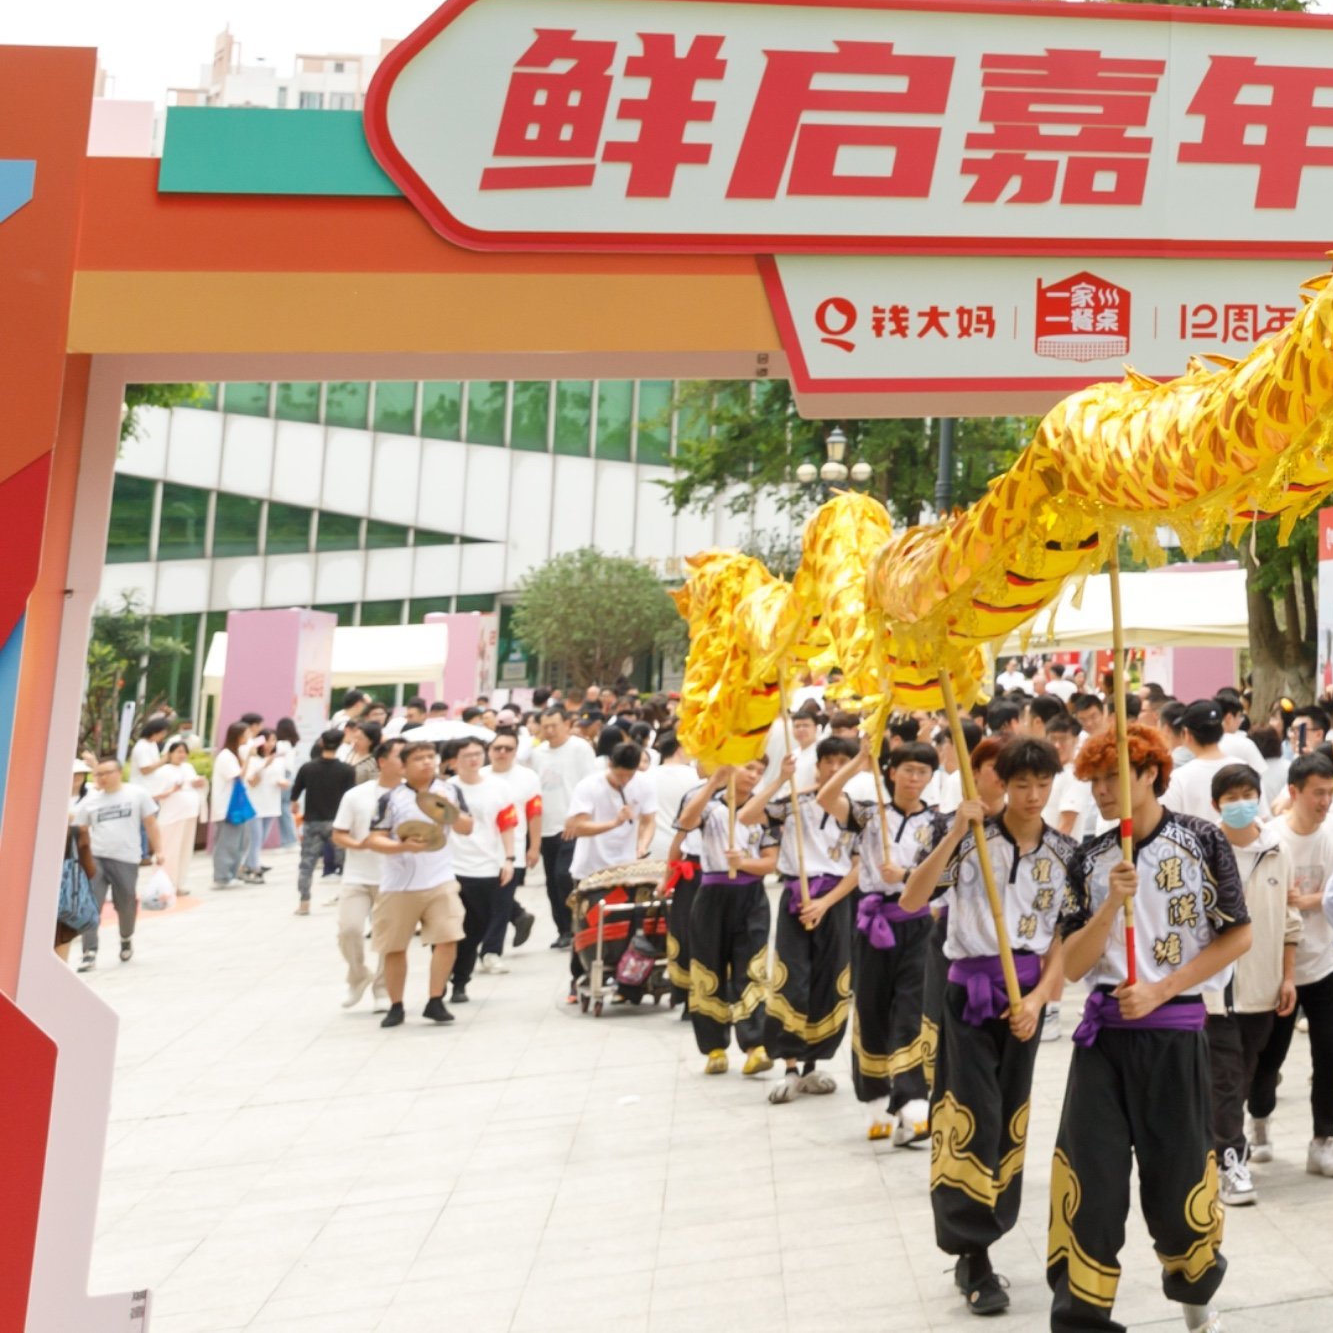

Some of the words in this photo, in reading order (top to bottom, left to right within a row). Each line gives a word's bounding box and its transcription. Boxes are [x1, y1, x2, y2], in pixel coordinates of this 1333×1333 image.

[1046, 282, 1096, 308] 一家
[873, 305, 997, 340] 钱大妈
[1046, 308, 1120, 333] 一餐桌
